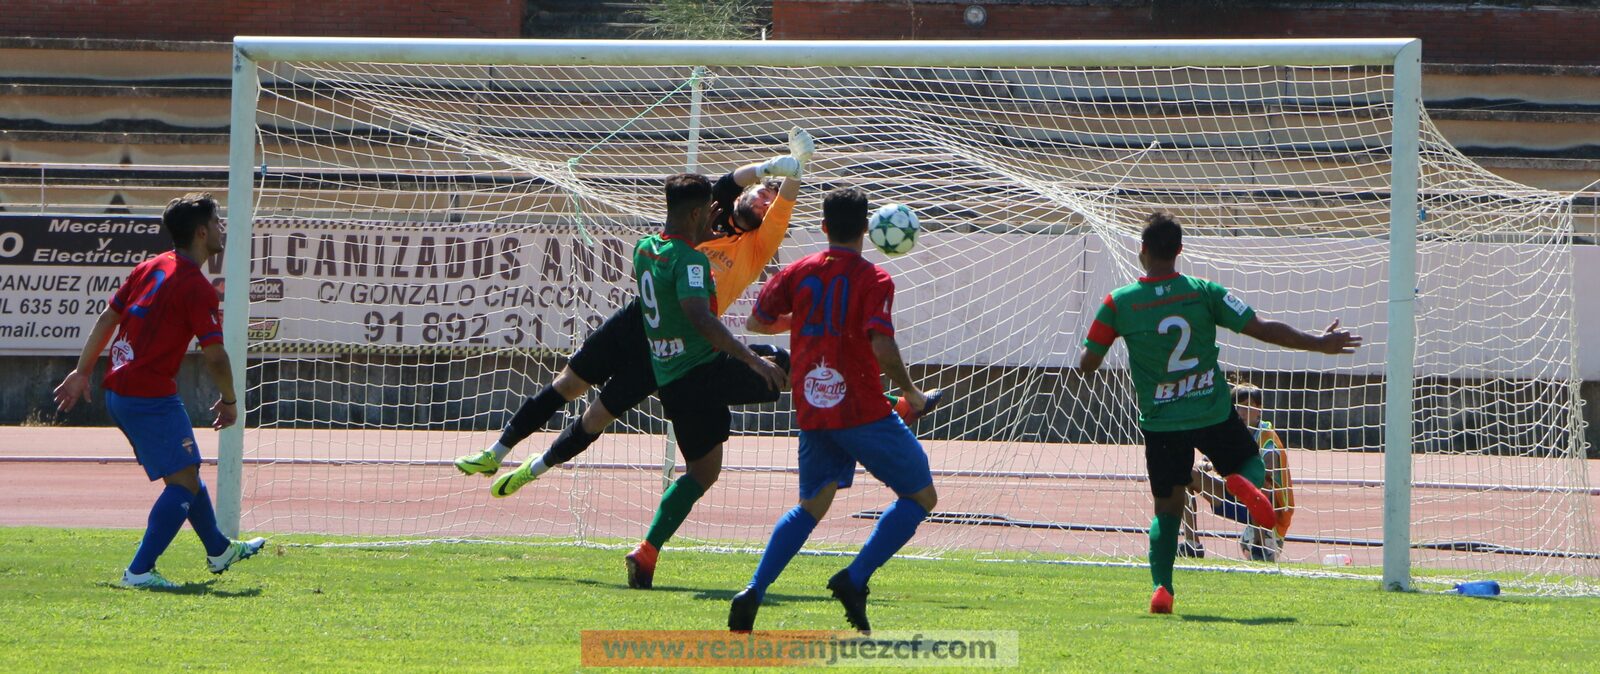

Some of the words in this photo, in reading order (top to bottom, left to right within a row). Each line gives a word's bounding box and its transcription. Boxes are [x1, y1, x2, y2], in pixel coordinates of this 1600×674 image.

[48, 218, 161, 235] Mecánica
[32, 248, 160, 264] Electricida
[96, 237, 113, 251] y
[207, 232, 522, 281] VLCANIZADOS
[0, 274, 82, 292] ANJUEZ
[86, 275, 129, 296] (MA
[128, 269, 166, 318] 2
[250, 283, 281, 294] KOOK
[350, 283, 477, 307] GONZALO
[20, 298, 51, 315] 635
[57, 298, 79, 315] 50
[641, 270, 660, 328] 9
[796, 274, 849, 336] 20
[364, 310, 405, 343] 91
[422, 311, 489, 344] 892
[503, 313, 543, 345] 31
[1157, 315, 1200, 373] 2
